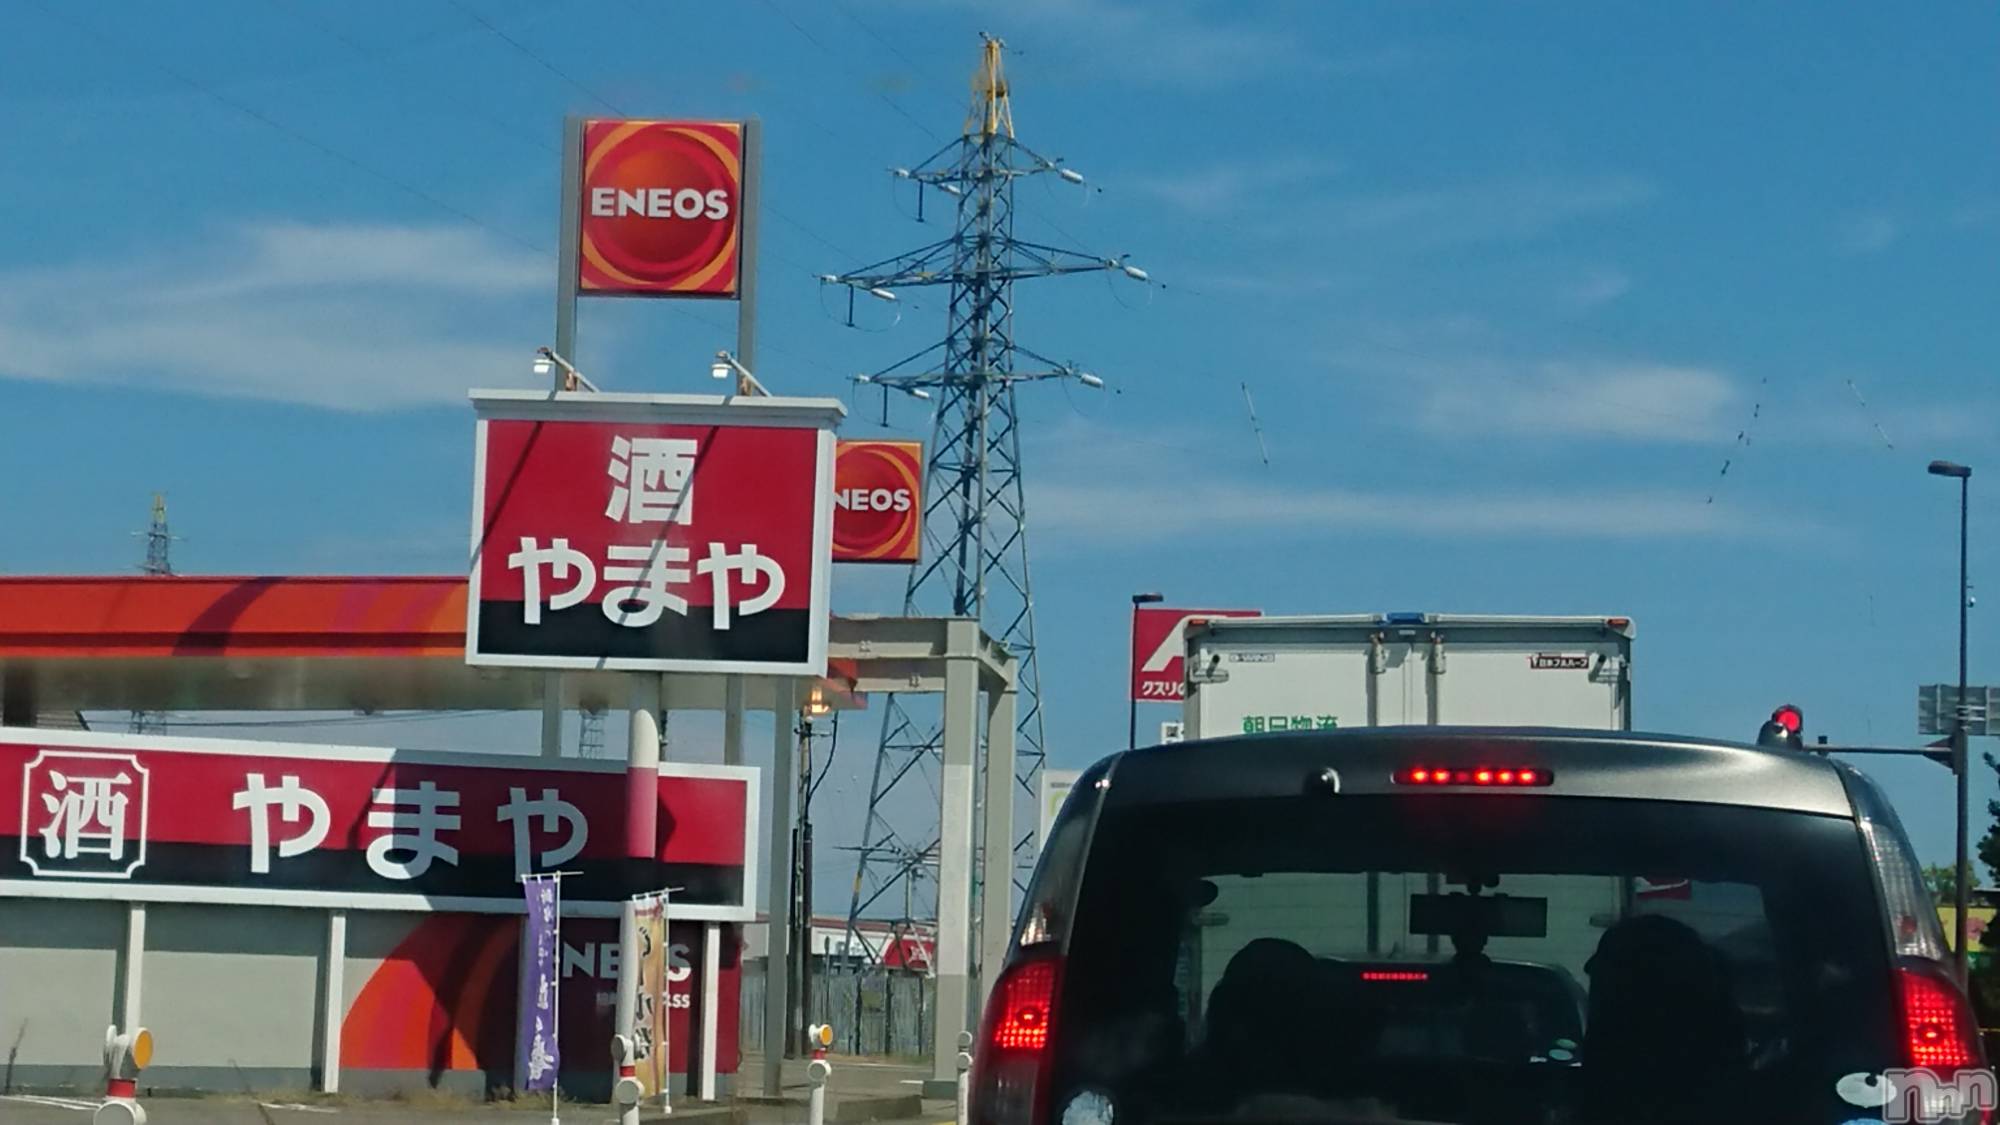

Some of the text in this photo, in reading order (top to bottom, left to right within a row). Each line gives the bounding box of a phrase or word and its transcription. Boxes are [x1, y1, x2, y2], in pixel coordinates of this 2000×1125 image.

[590, 187, 729, 221] ENEOS
[605, 435, 698, 526] 酒
[832, 488, 911, 512] NEOS
[507, 537, 786, 632] やまや
[1242, 715, 1338, 733] 朝日物流
[38, 771, 589, 883] 酒 やまや
[562, 942, 692, 982] NES
